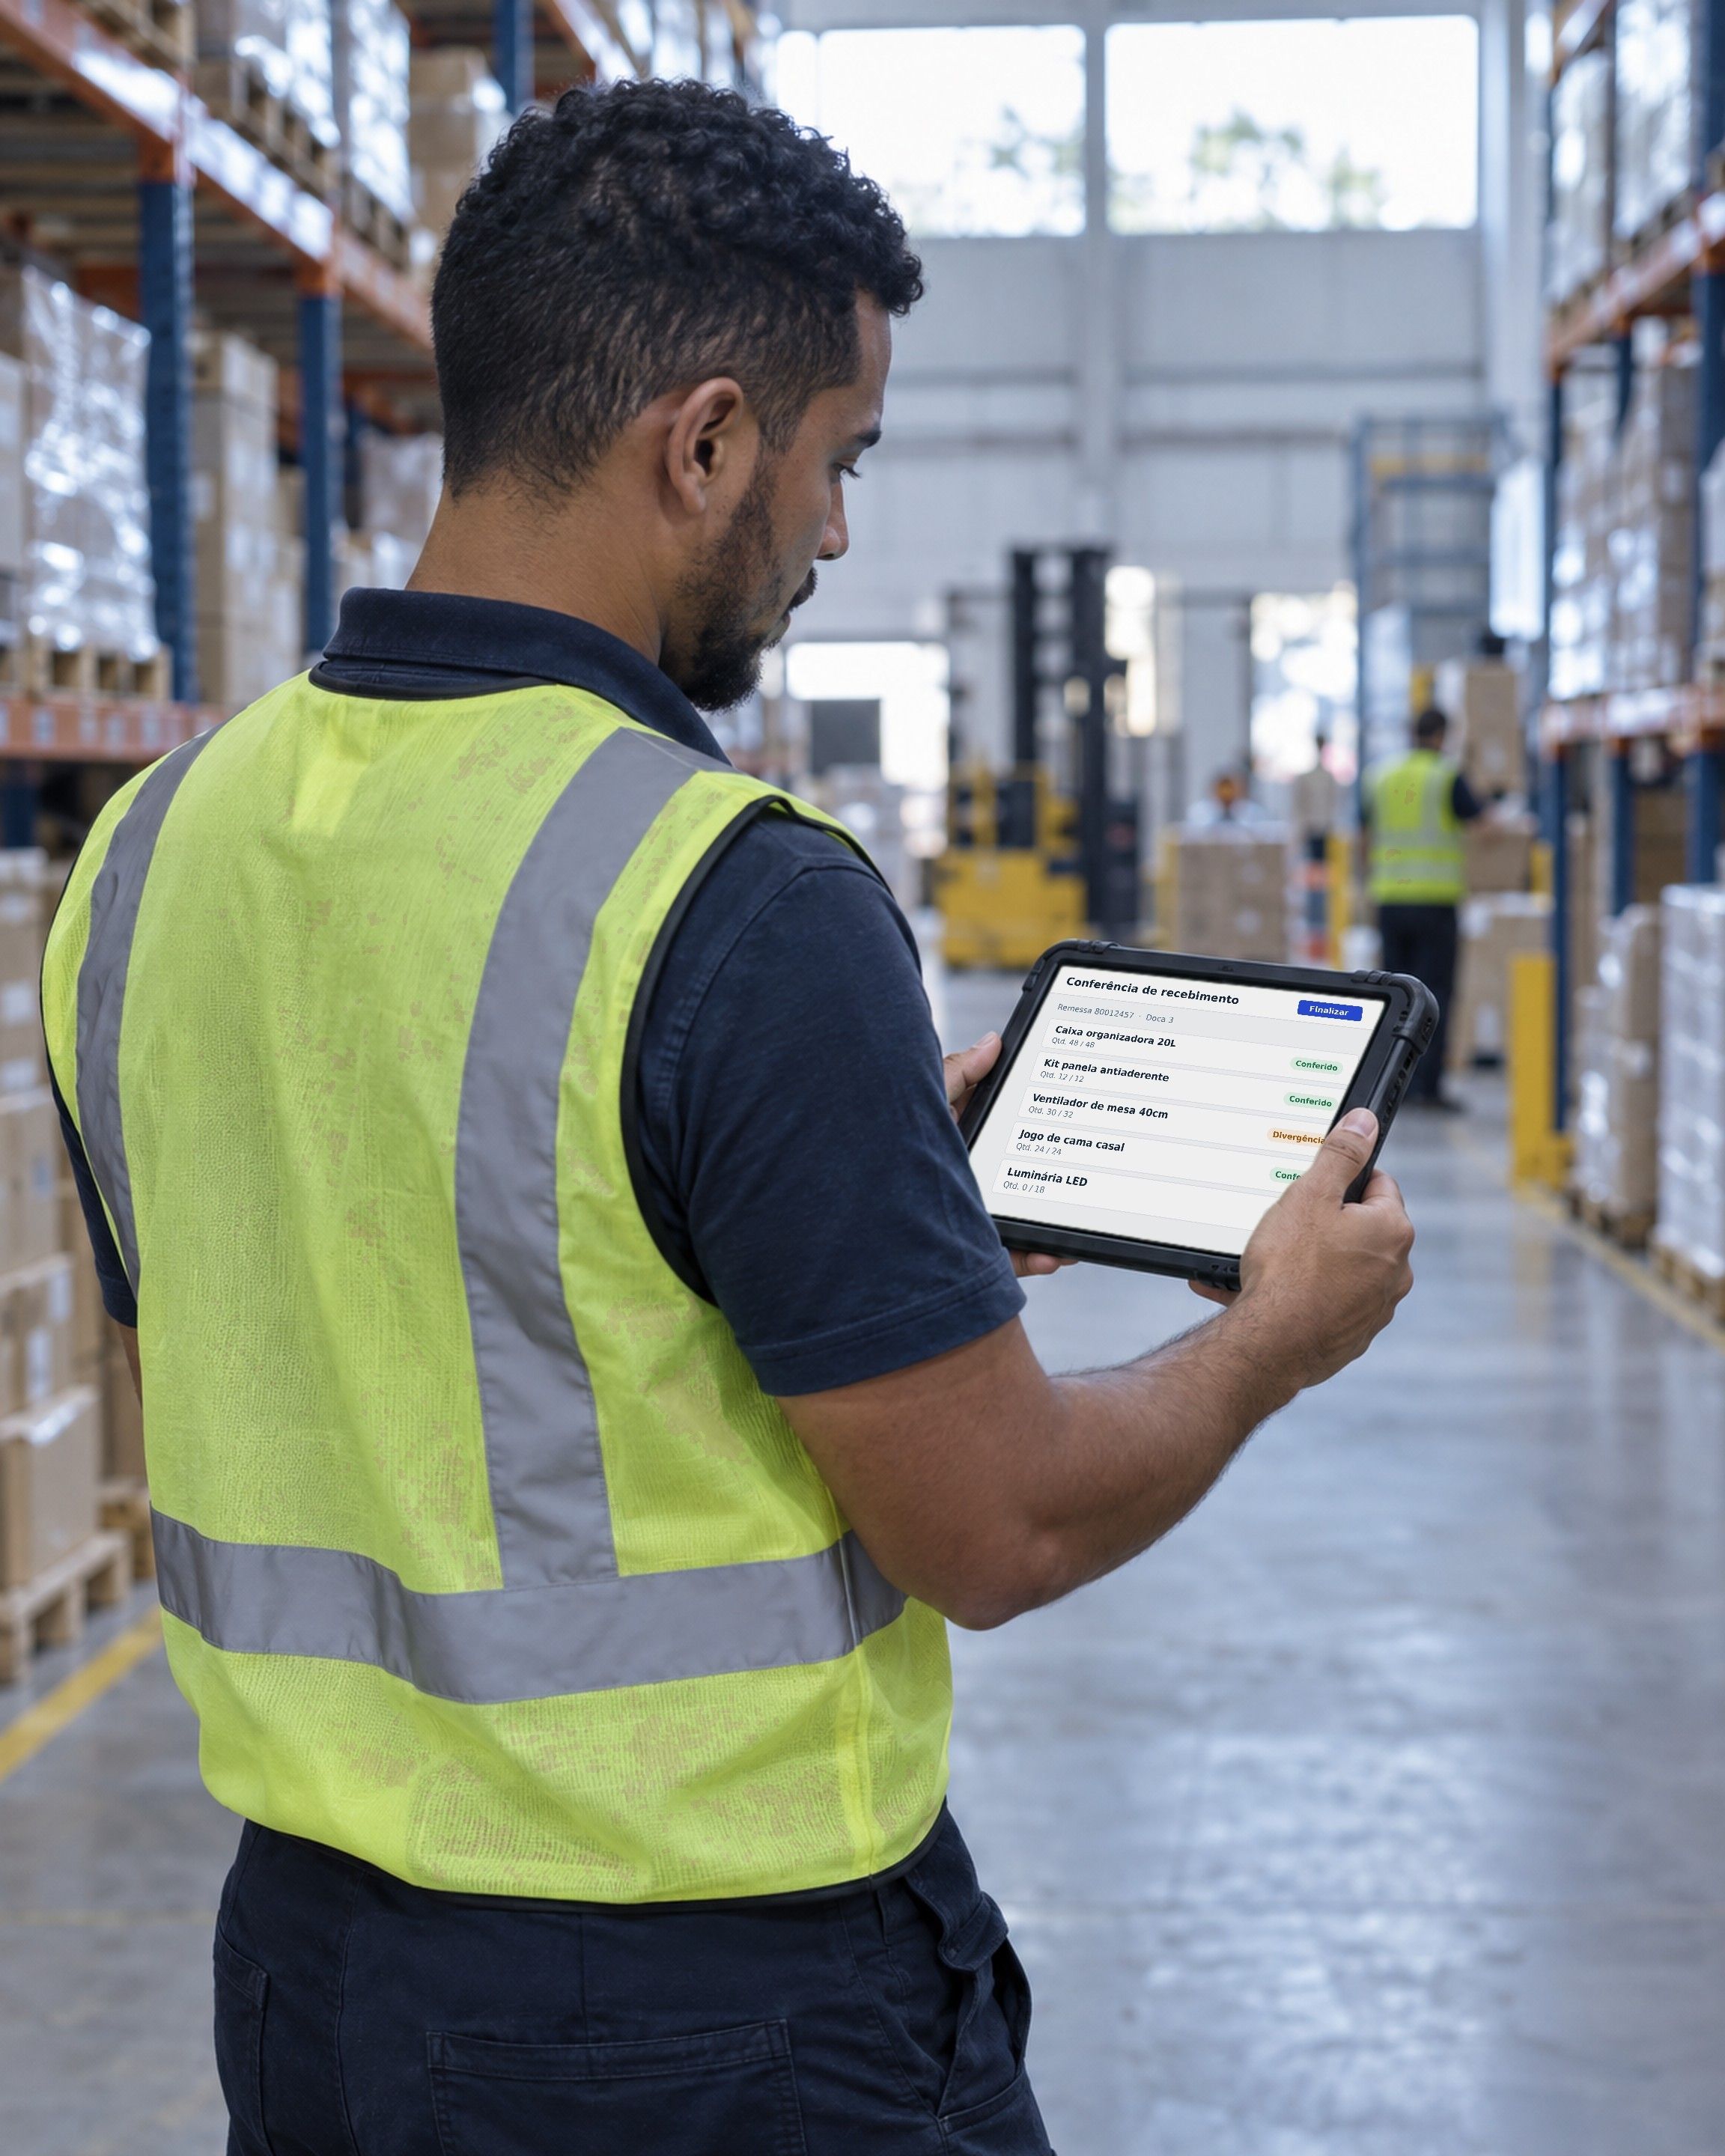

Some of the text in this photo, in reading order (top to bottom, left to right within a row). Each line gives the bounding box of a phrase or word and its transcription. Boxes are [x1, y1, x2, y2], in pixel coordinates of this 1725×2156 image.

[1066, 977, 1239, 1005] Conferência de recebimento
[1057, 1003, 1092, 1014] Remessa
[1094, 1008, 1134, 1019] 80012457
[1146, 1014, 1166, 1023] Doca
[1309, 1005, 1349, 1016] Finalizar
[1051, 1037, 1066, 1045] Qtd.
[1055, 1026, 1176, 1047] Caixa organizadora 20L
[1044, 1059, 1169, 1082] Kit panela antiaderente
[1295, 1060, 1338, 1071] Conferido
[1040, 1071, 1056, 1079] Qtd.
[1033, 1093, 1168, 1119] Ventilador de mesa 40cm
[1289, 1095, 1332, 1107] Conferido
[1028, 1106, 1044, 1115] Qtd.
[1018, 1130, 1125, 1152] Jogo de cama casal
[1016, 1142, 1031, 1151] Qtd.
[1051, 1148, 1062, 1156] 24
[1007, 1167, 1088, 1187] Luminária LED
[1275, 1171, 1301, 1181] Confe
[1003, 1181, 1019, 1190] Qtd.
[1035, 1185, 1045, 1194] 18
